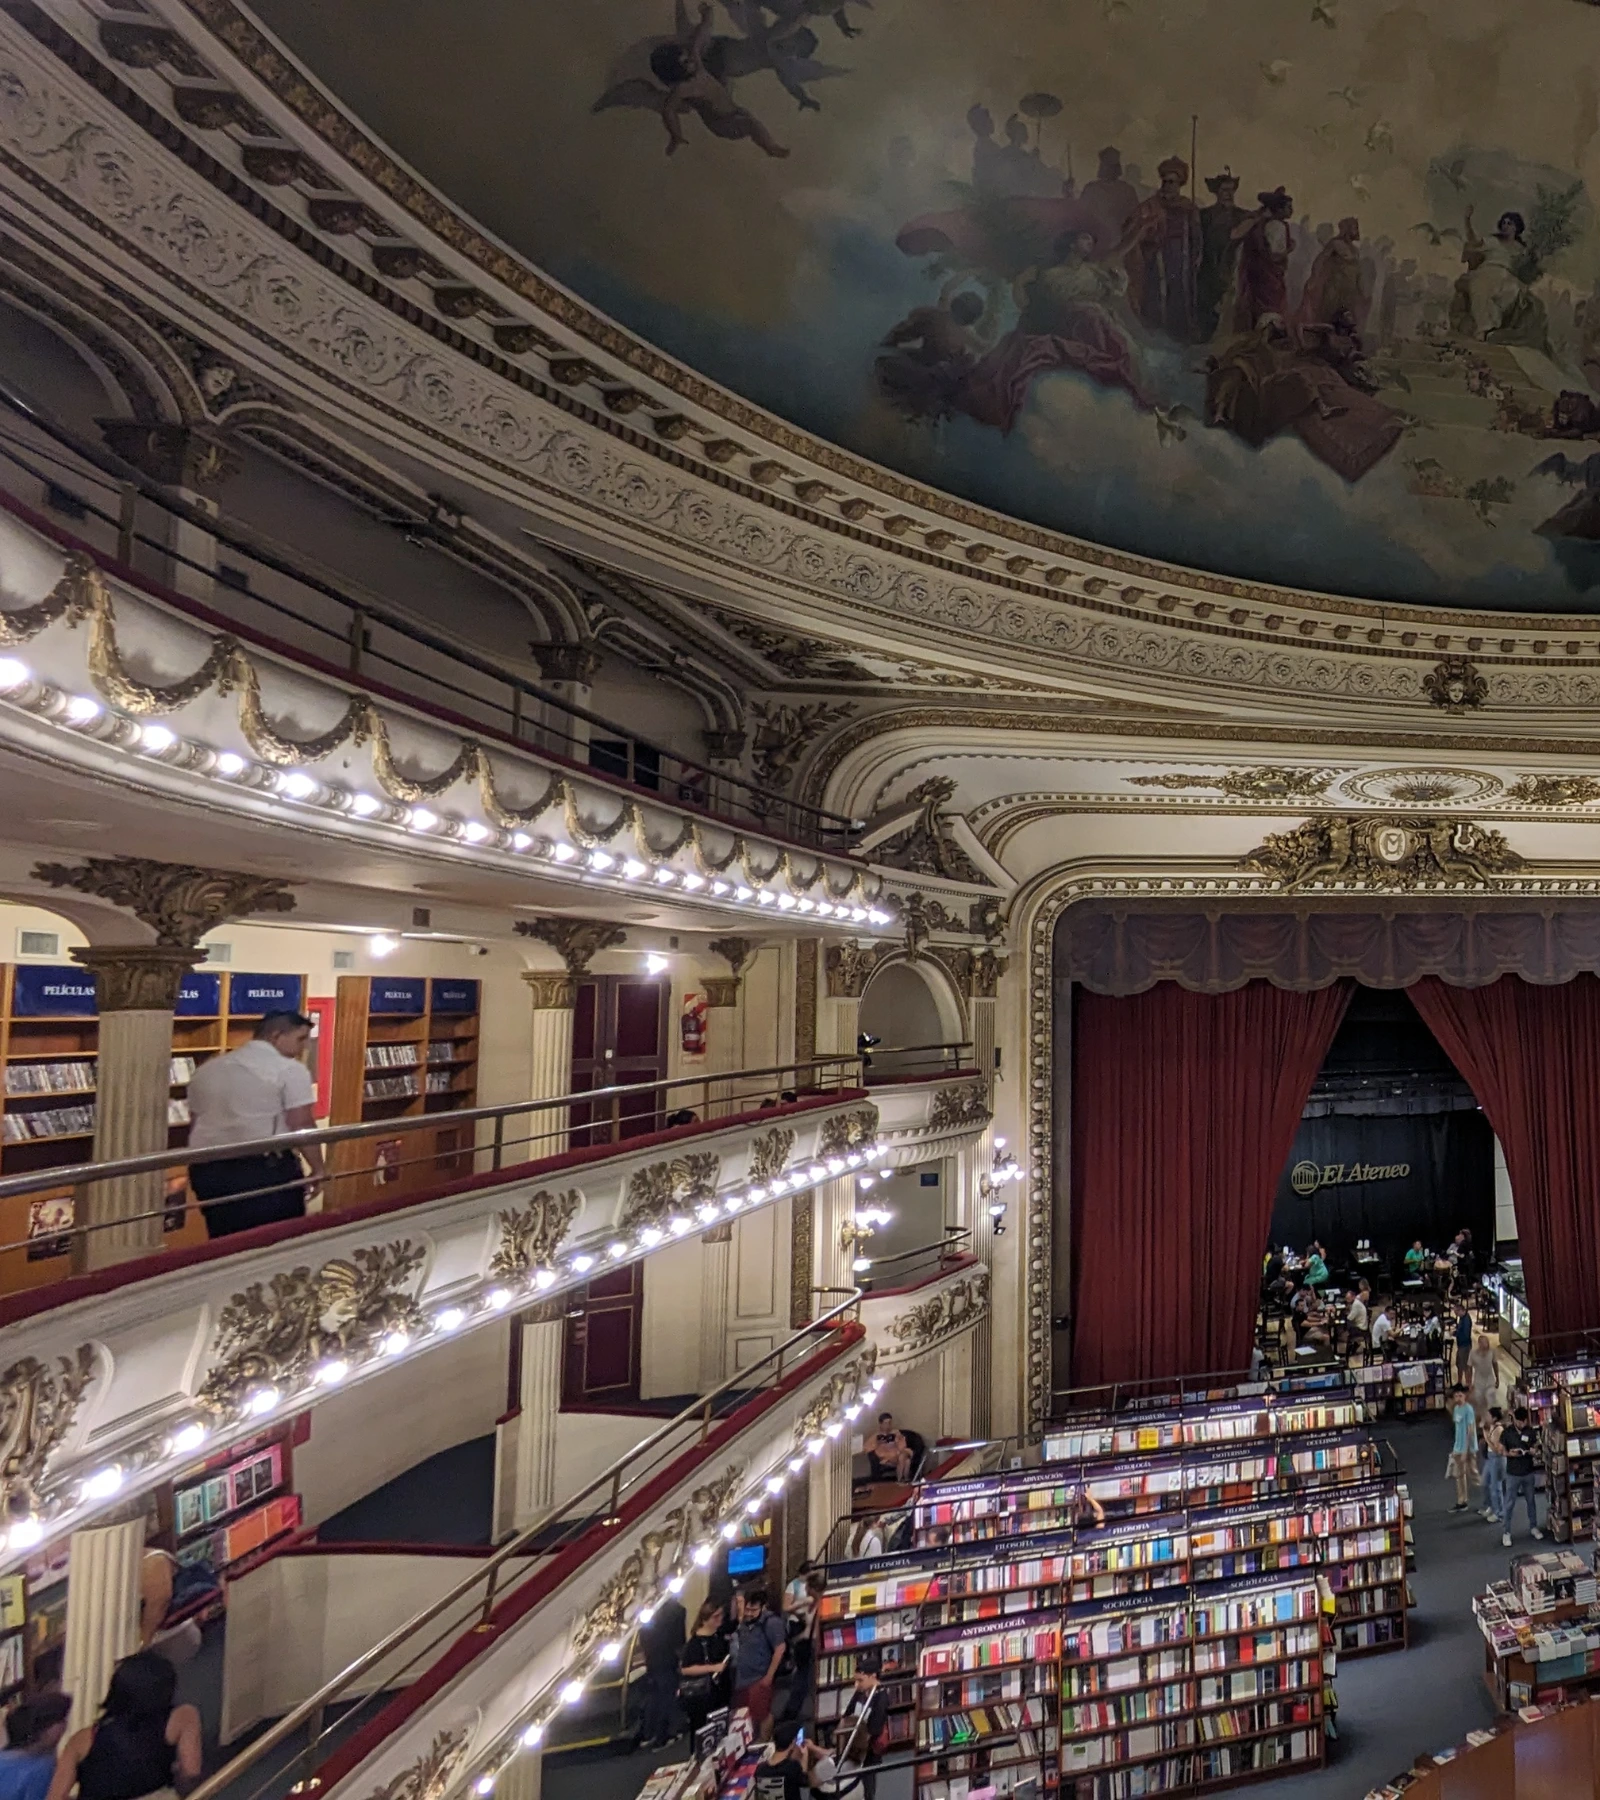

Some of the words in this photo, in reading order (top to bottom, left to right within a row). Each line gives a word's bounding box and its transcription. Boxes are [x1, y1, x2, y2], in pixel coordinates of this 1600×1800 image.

[43, 983, 96, 996] PELÍCULAS
[247, 987, 285, 998] PELÍCULAS
[1320, 1163, 1345, 1185] El
[1345, 1162, 1411, 1183] Ateneo
[1211, 1449, 1251, 1460] ESOTERISMO
[1113, 1460, 1152, 1471] ASTROLOGÍA
[1022, 1471, 1064, 1483] ADIVINACIÓN
[935, 1482, 986, 1496] ORIENTALISMO
[1348, 1482, 1385, 1496] ESCRITORES
[960, 1617, 1027, 1638] ANTROPOLOGÍA
